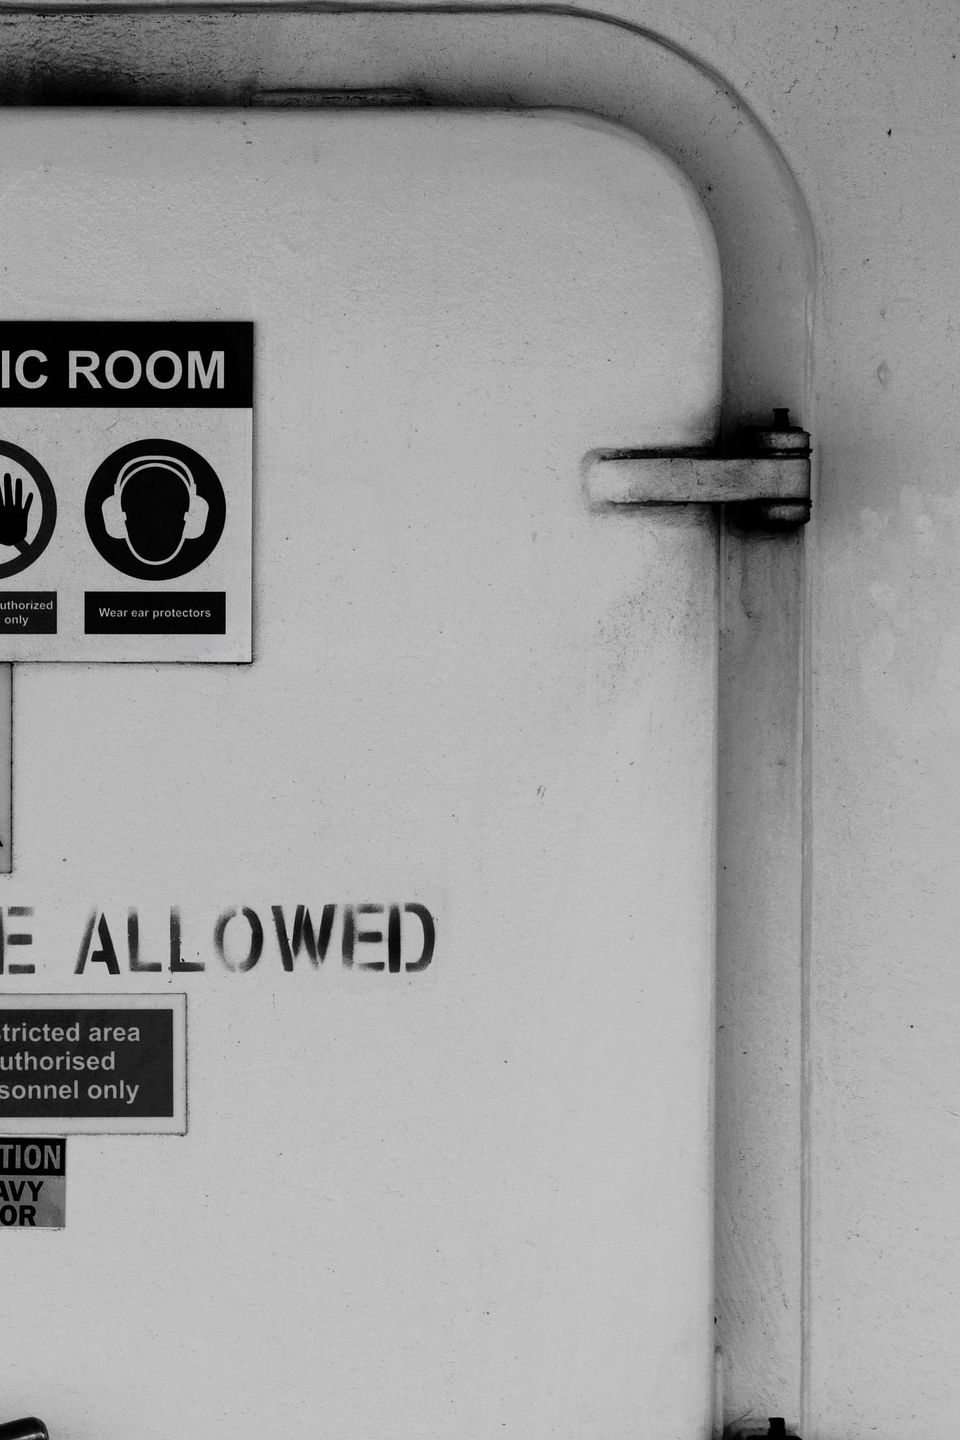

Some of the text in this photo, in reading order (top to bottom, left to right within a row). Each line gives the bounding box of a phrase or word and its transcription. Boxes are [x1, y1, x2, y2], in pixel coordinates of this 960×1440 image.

[69, 350, 224, 389] ROOM
[4, 615, 28, 626] only
[99, 608, 127, 617] Wear
[153, 609, 211, 619] protectors
[75, 903, 435, 975] ALLOWED
[89, 1027, 139, 1041] area
[88, 1080, 139, 1104] only
